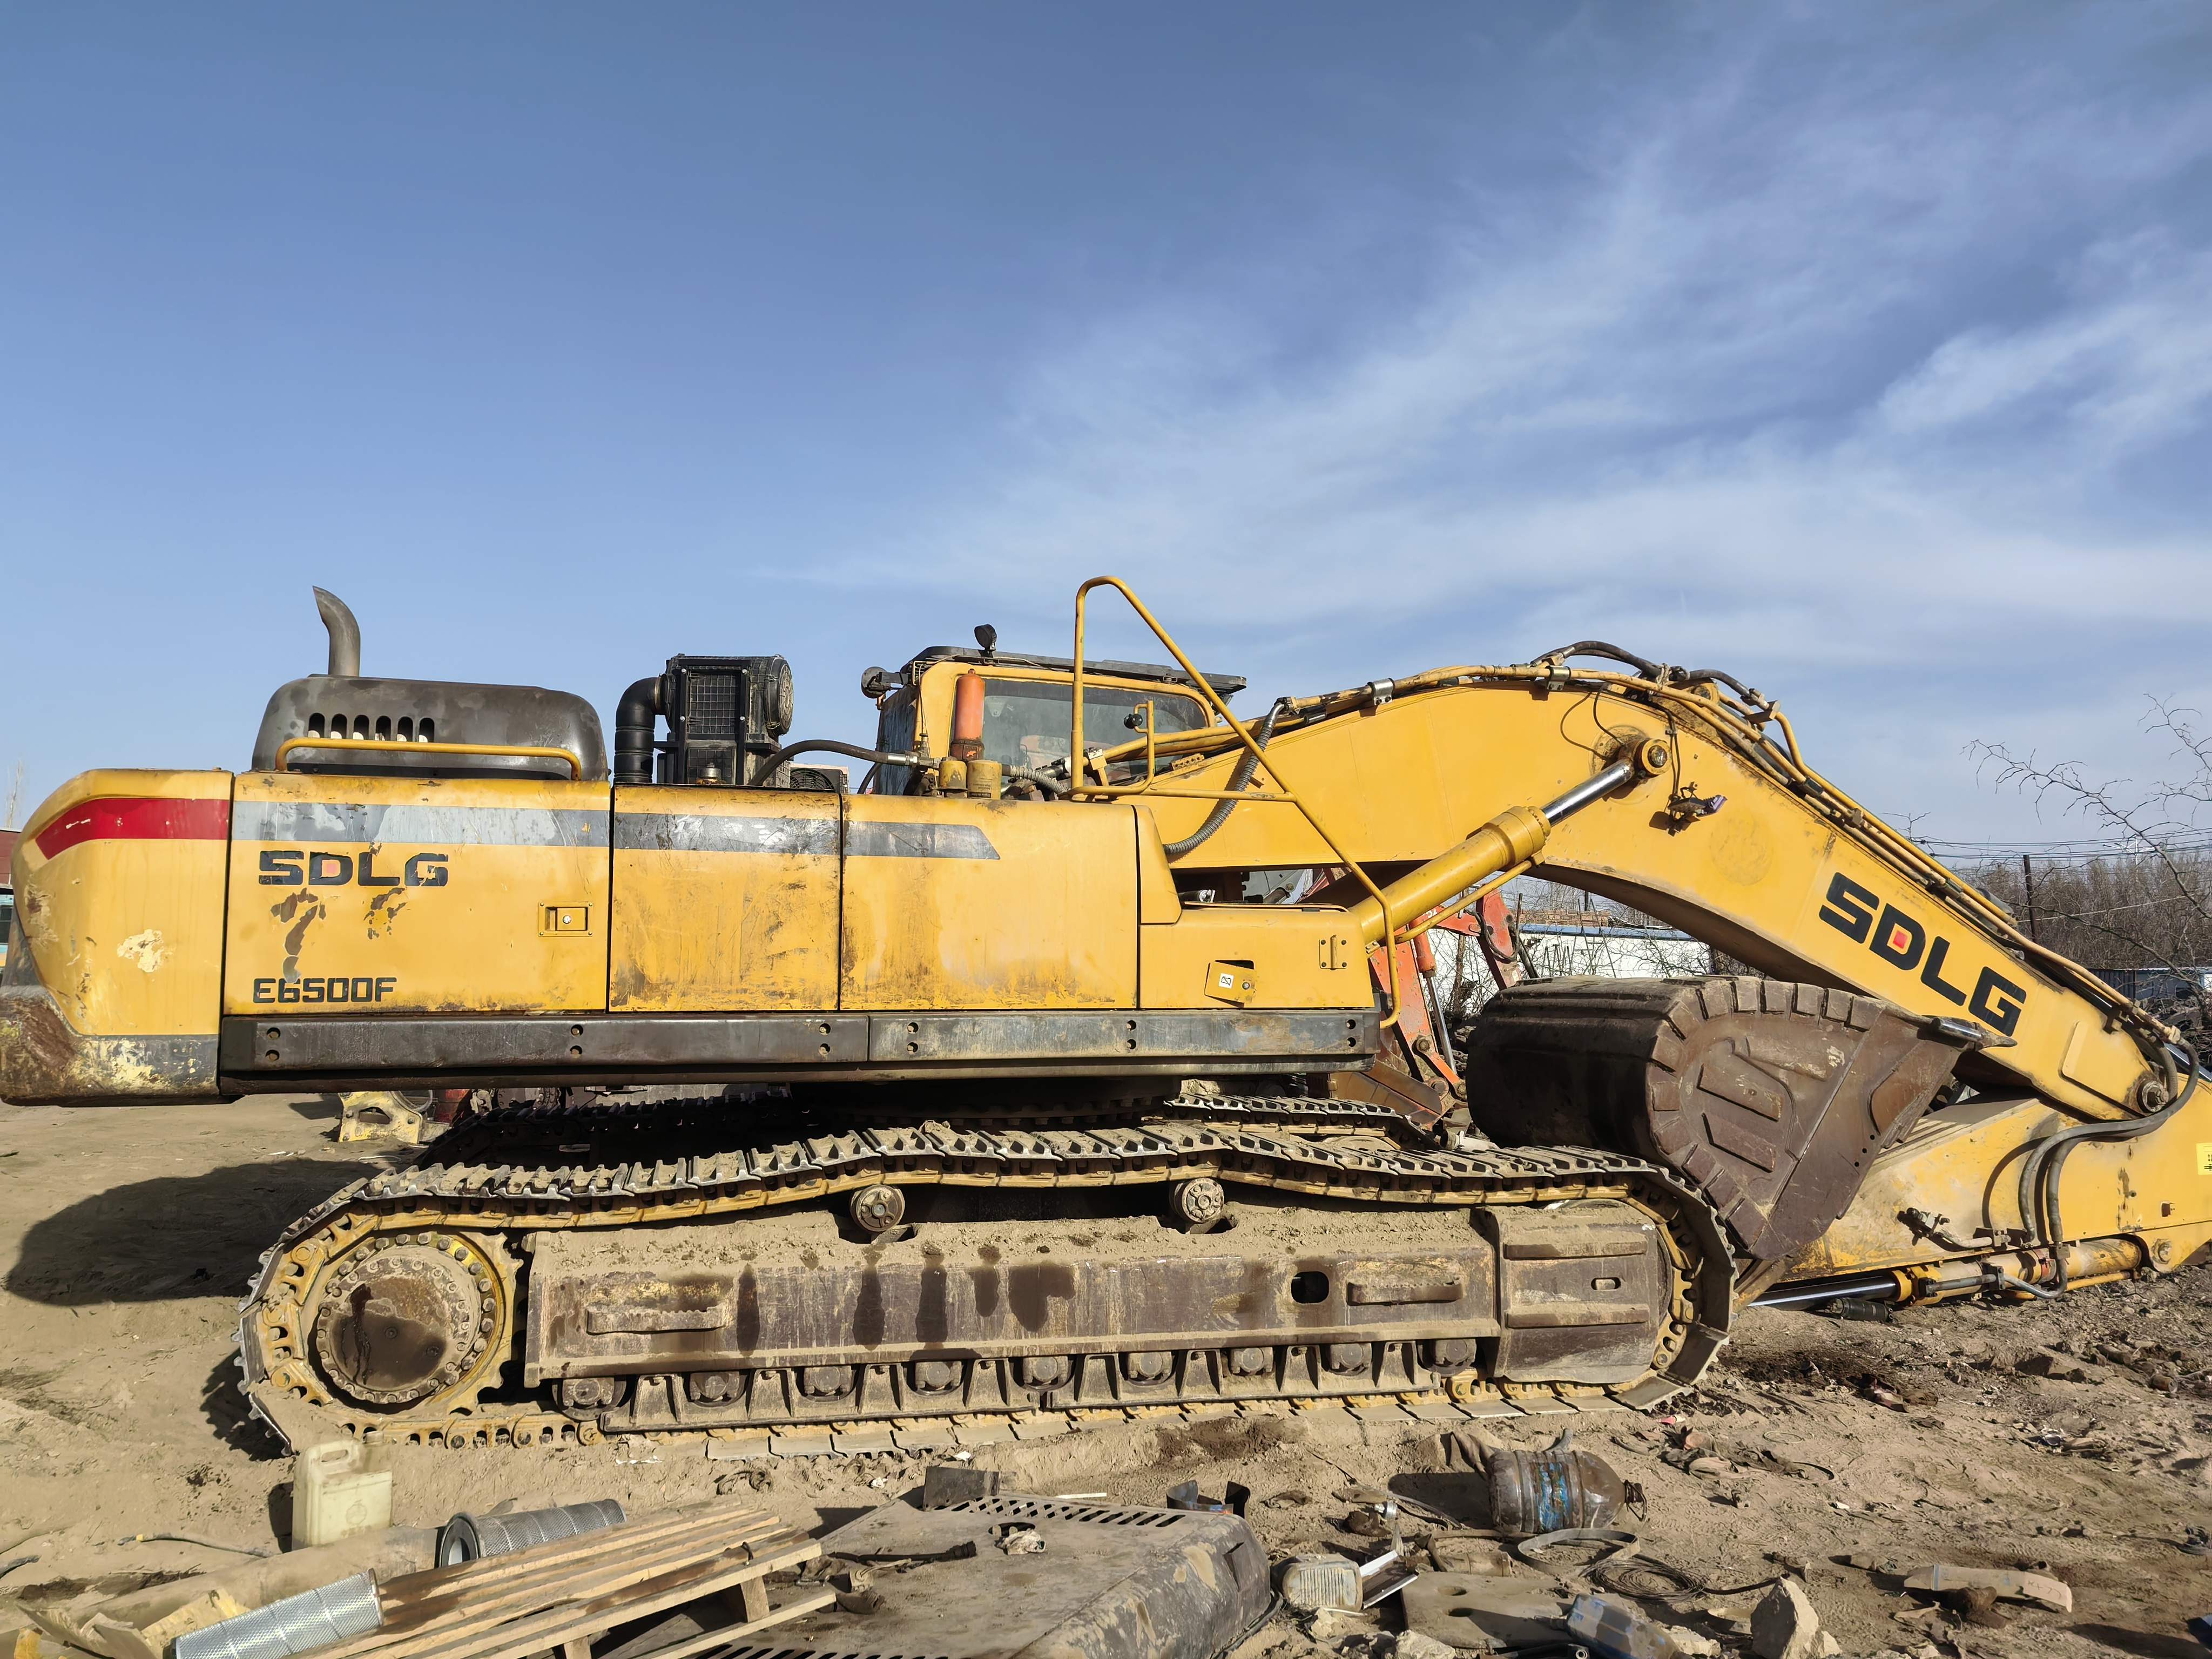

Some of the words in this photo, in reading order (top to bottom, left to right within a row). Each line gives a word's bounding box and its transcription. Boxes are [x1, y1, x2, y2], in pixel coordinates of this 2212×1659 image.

[259, 850, 449, 887] SDLG
[1819, 872, 2027, 1037] SDLG
[253, 977, 397, 1003] E6500F
